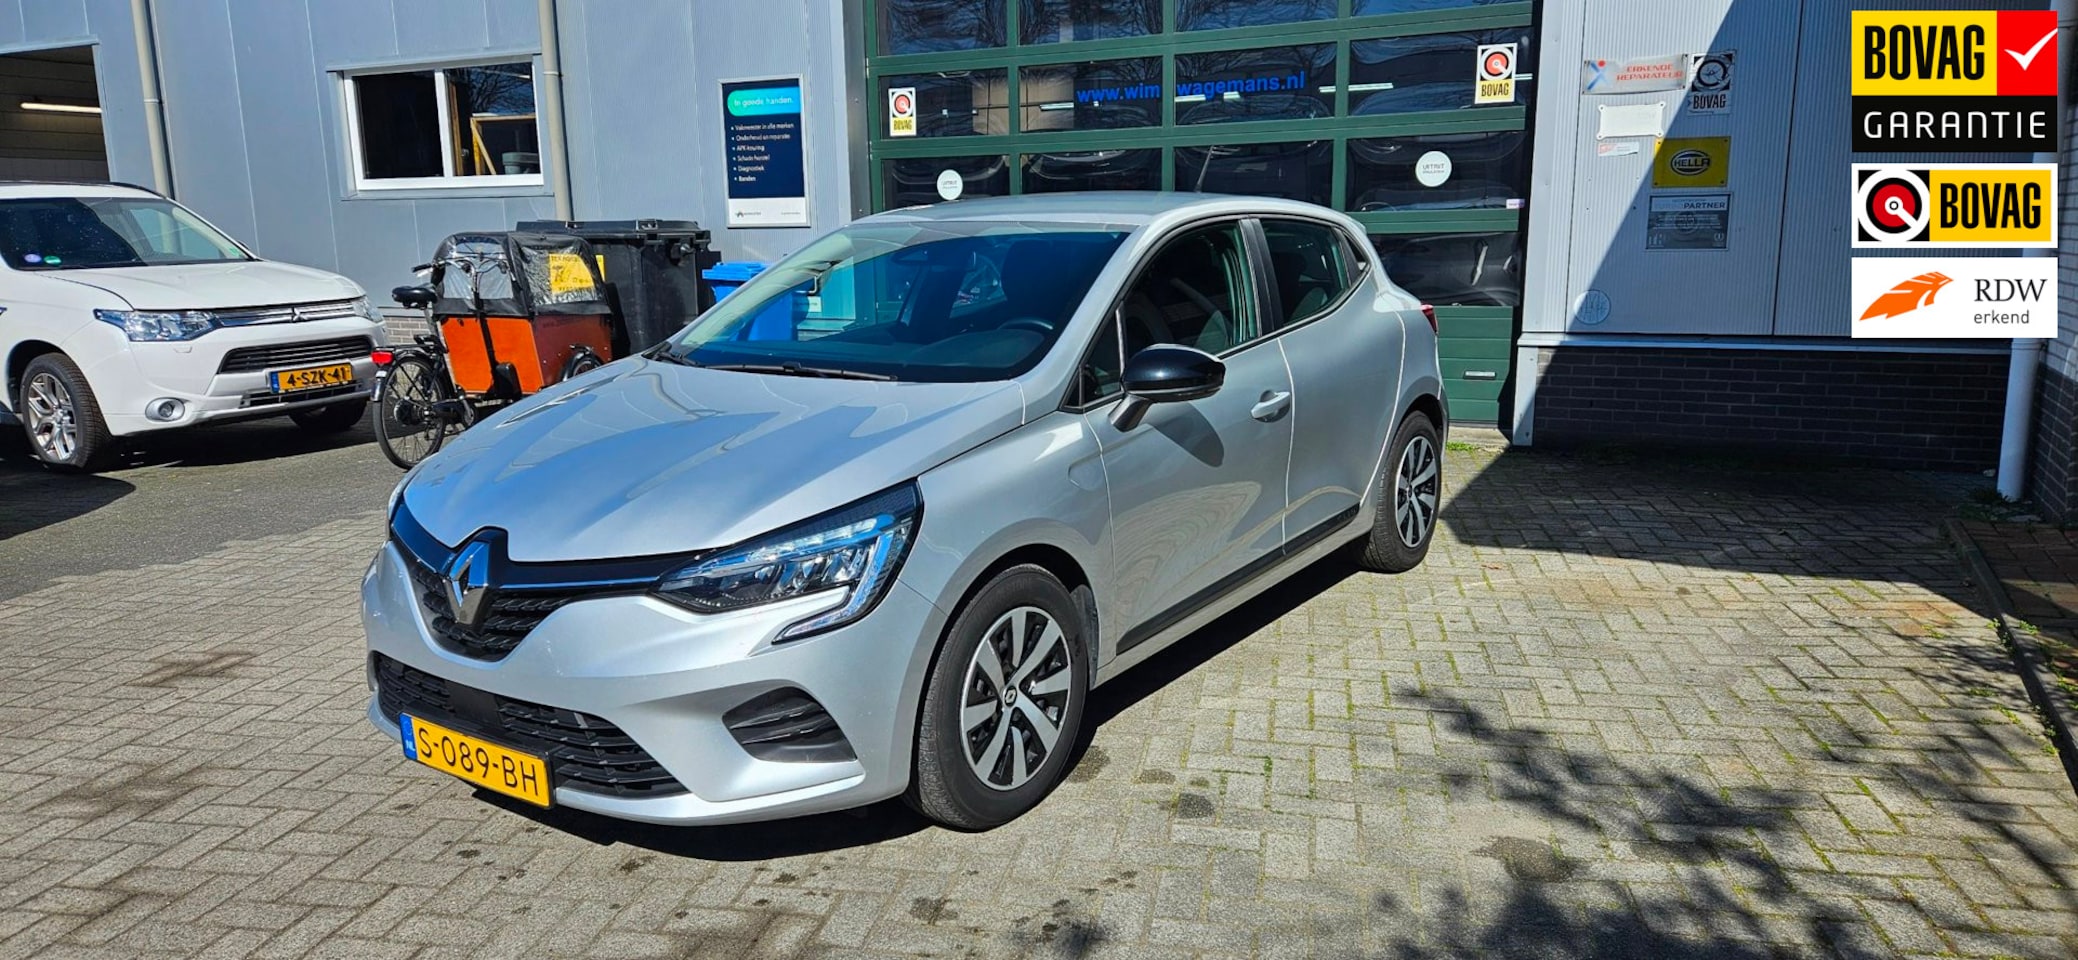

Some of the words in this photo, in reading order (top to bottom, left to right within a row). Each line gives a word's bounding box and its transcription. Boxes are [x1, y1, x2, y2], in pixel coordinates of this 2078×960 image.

[1626, 64, 1673, 73] ERKENDE
[1616, 70, 1684, 81] REPARATEUR
[1481, 83, 1509, 96] BOVAG
[1693, 94, 1727, 109] BOVAG
[1674, 157, 1710, 167] HELLA
[287, 367, 347, 387] 4-SZK-41
[405, 739, 416, 751] NL
[418, 727, 539, 797] S-089-BH
